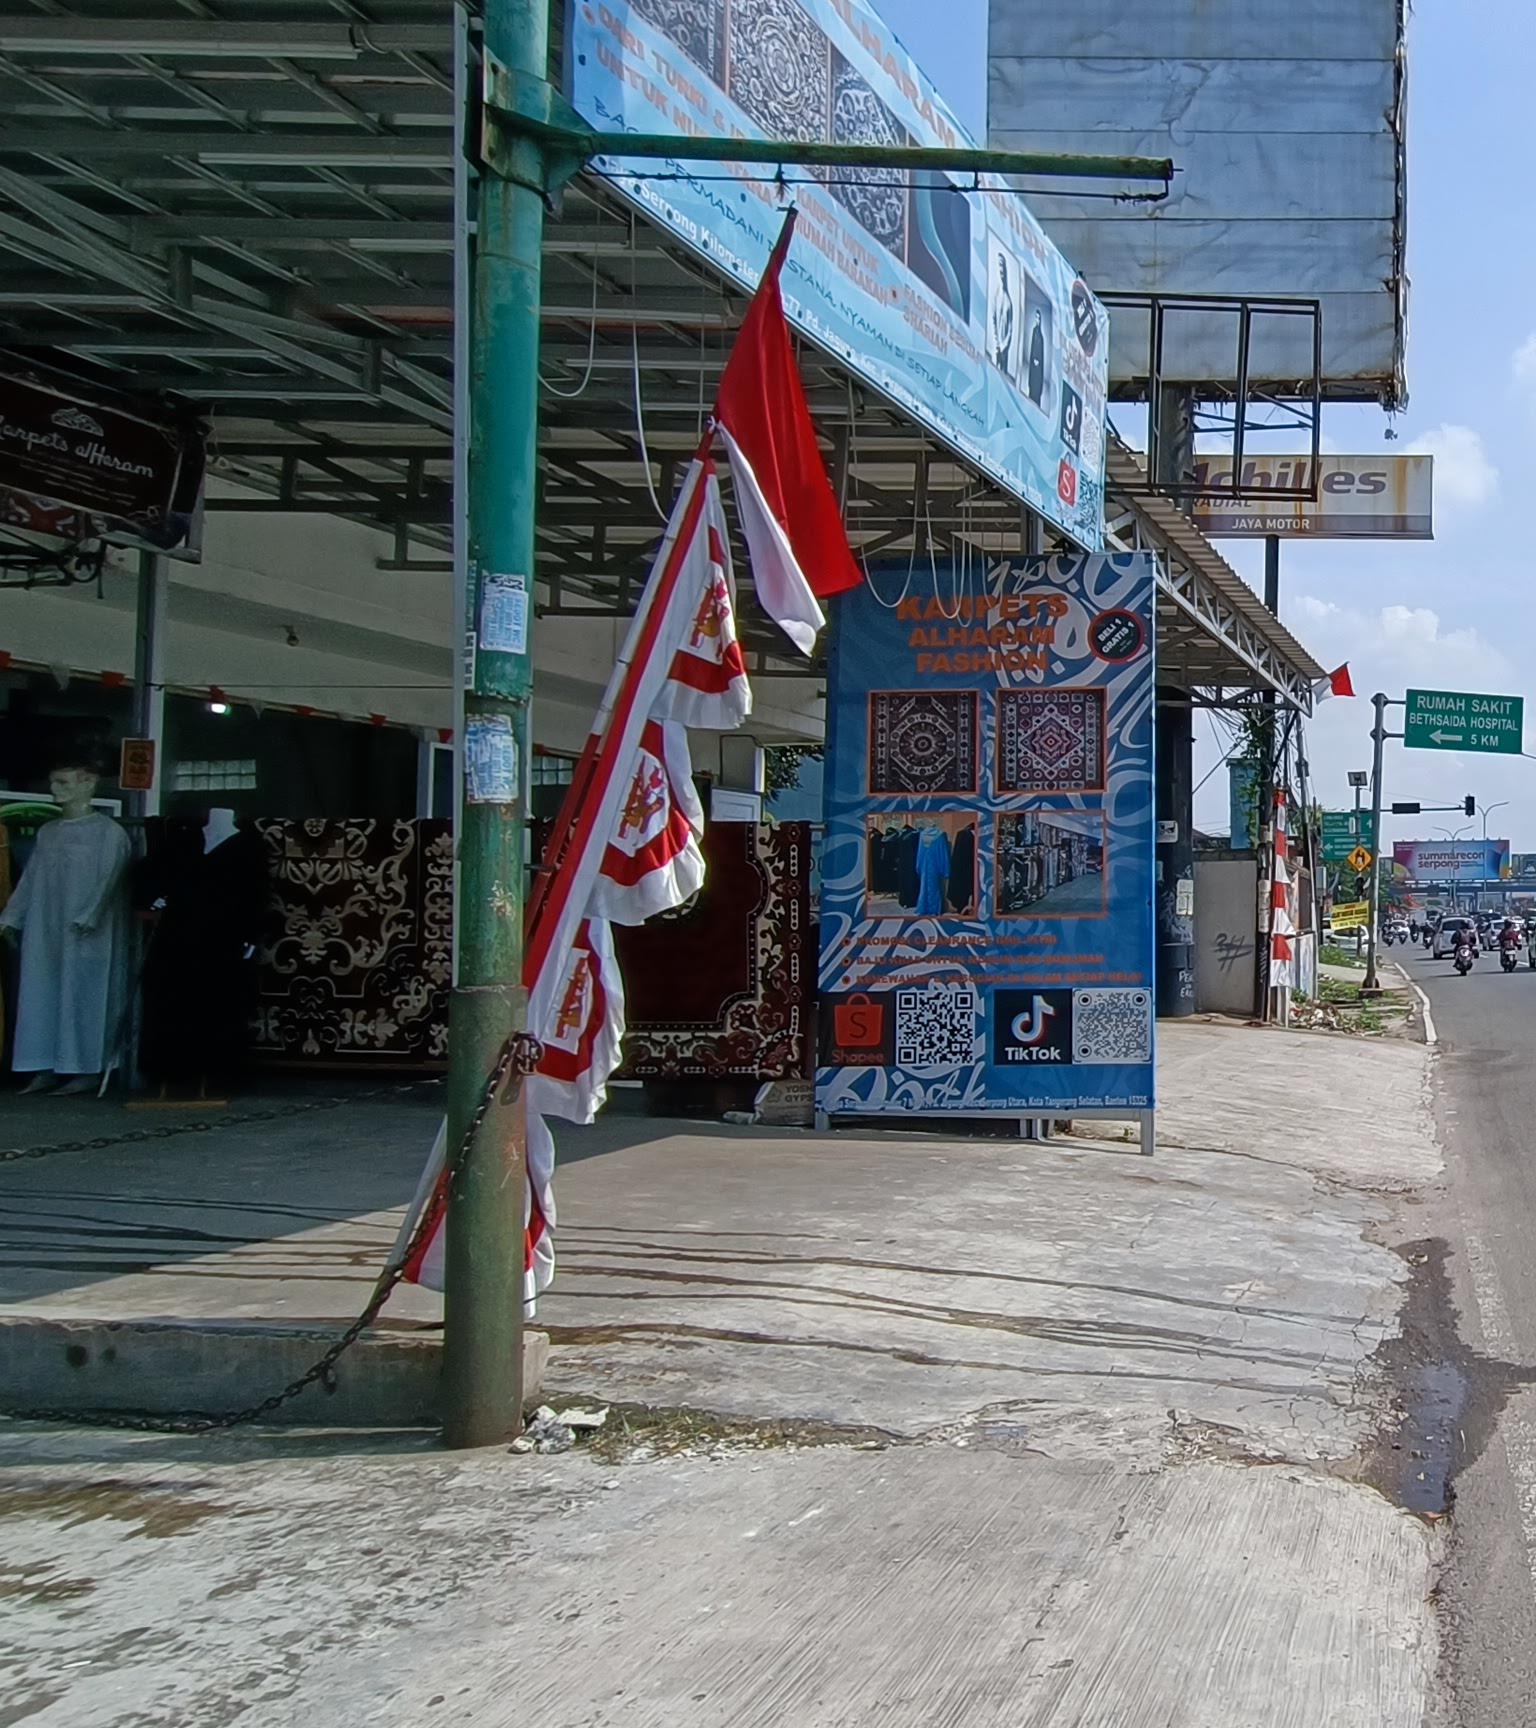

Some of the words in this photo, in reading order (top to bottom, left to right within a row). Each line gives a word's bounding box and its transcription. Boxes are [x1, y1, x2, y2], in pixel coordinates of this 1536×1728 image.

[598, 1, 645, 61] DARI
[652, 50, 709, 117] TURKI
[597, 38, 669, 118] UNTUK
[832, 0, 956, 148] LHARAM
[786, 257, 836, 307] STANA,
[839, 302, 893, 350] NYAMAN
[906, 356, 942, 390] SETIAP
[0, 415, 69, 451] arpets
[1232, 518, 1263, 529] JAYA
[1266, 518, 1310, 529] MOTOR
[909, 627, 1055, 647] ALHARAM
[1097, 623, 1117, 642] BELI
[1102, 627, 1129, 653] GRATIS
[916, 653, 1048, 673] FASHION
[1417, 695, 1465, 711] RUMAH
[1471, 699, 1512, 714] SAKIT
[1409, 712, 1467, 728] BETHSAIDA
[1470, 716, 1519, 731] HOSPITAL
[1470, 734, 1477, 745] 5
[1481, 735, 1499, 746] KM
[1418, 850, 1485, 860] summarecon
[1418, 860, 1460, 870] serpong
[832, 1050, 884, 1064] Shopee
[1005, 1046, 1061, 1061] TikTok
